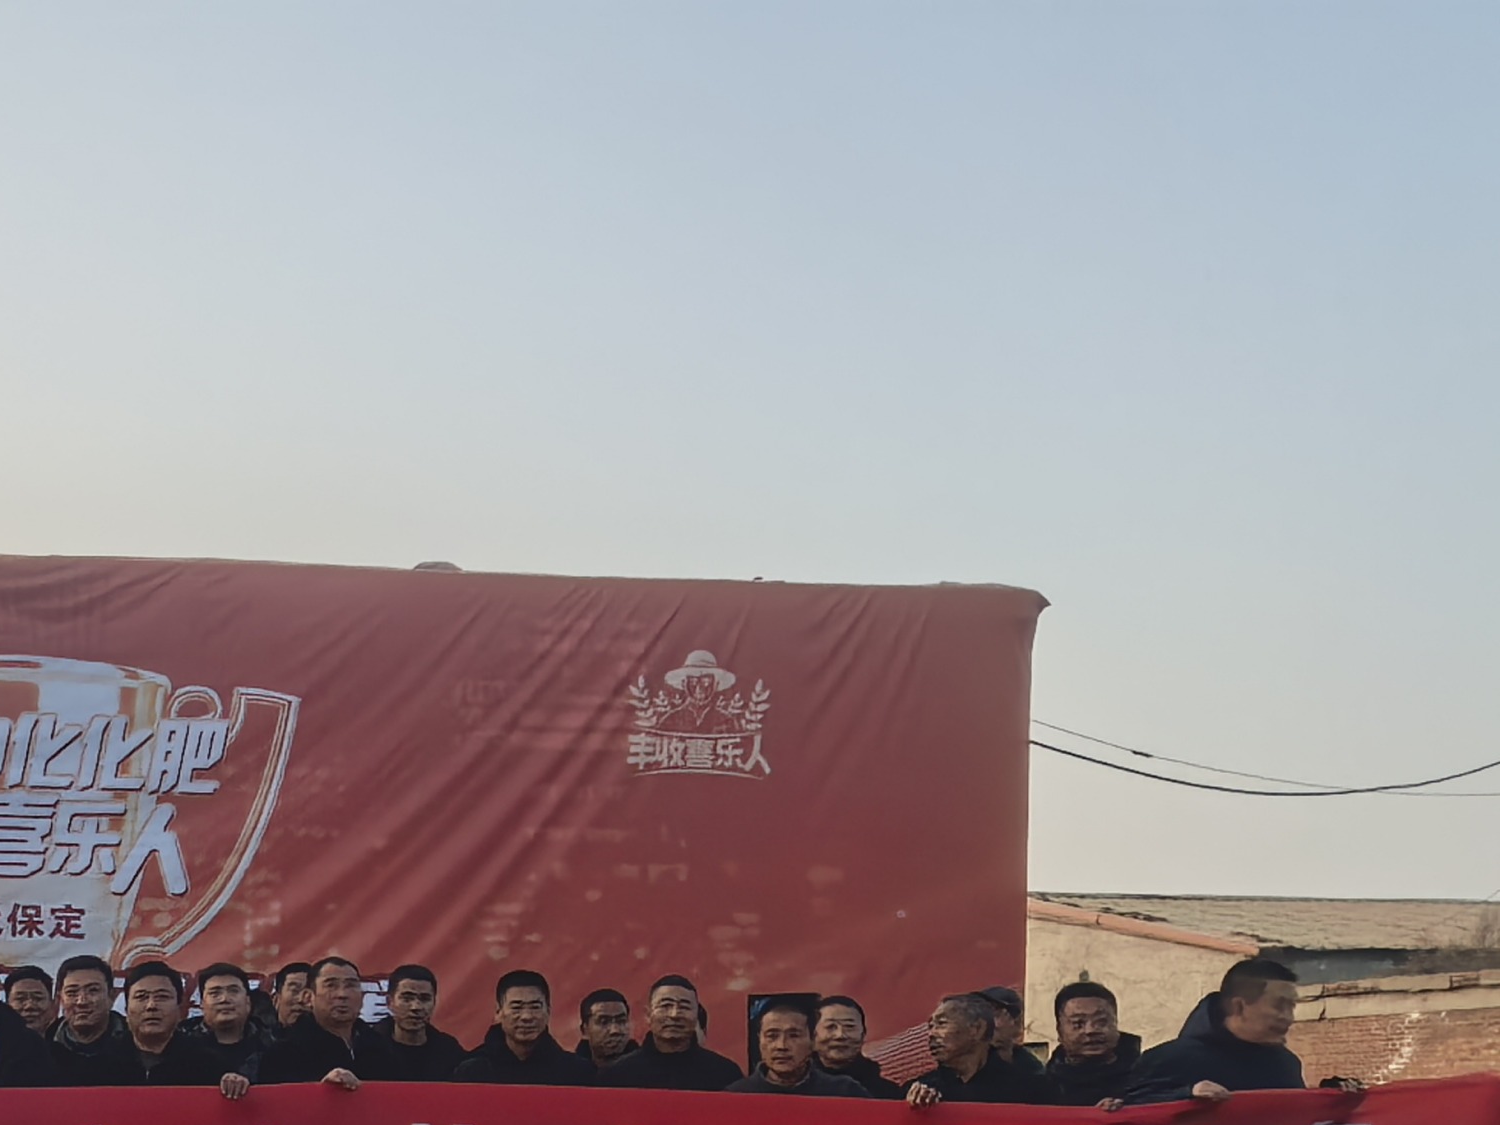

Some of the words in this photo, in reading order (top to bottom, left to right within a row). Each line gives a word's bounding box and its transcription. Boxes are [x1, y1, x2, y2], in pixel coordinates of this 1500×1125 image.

[626, 733, 772, 775] 丰收喜乐人
